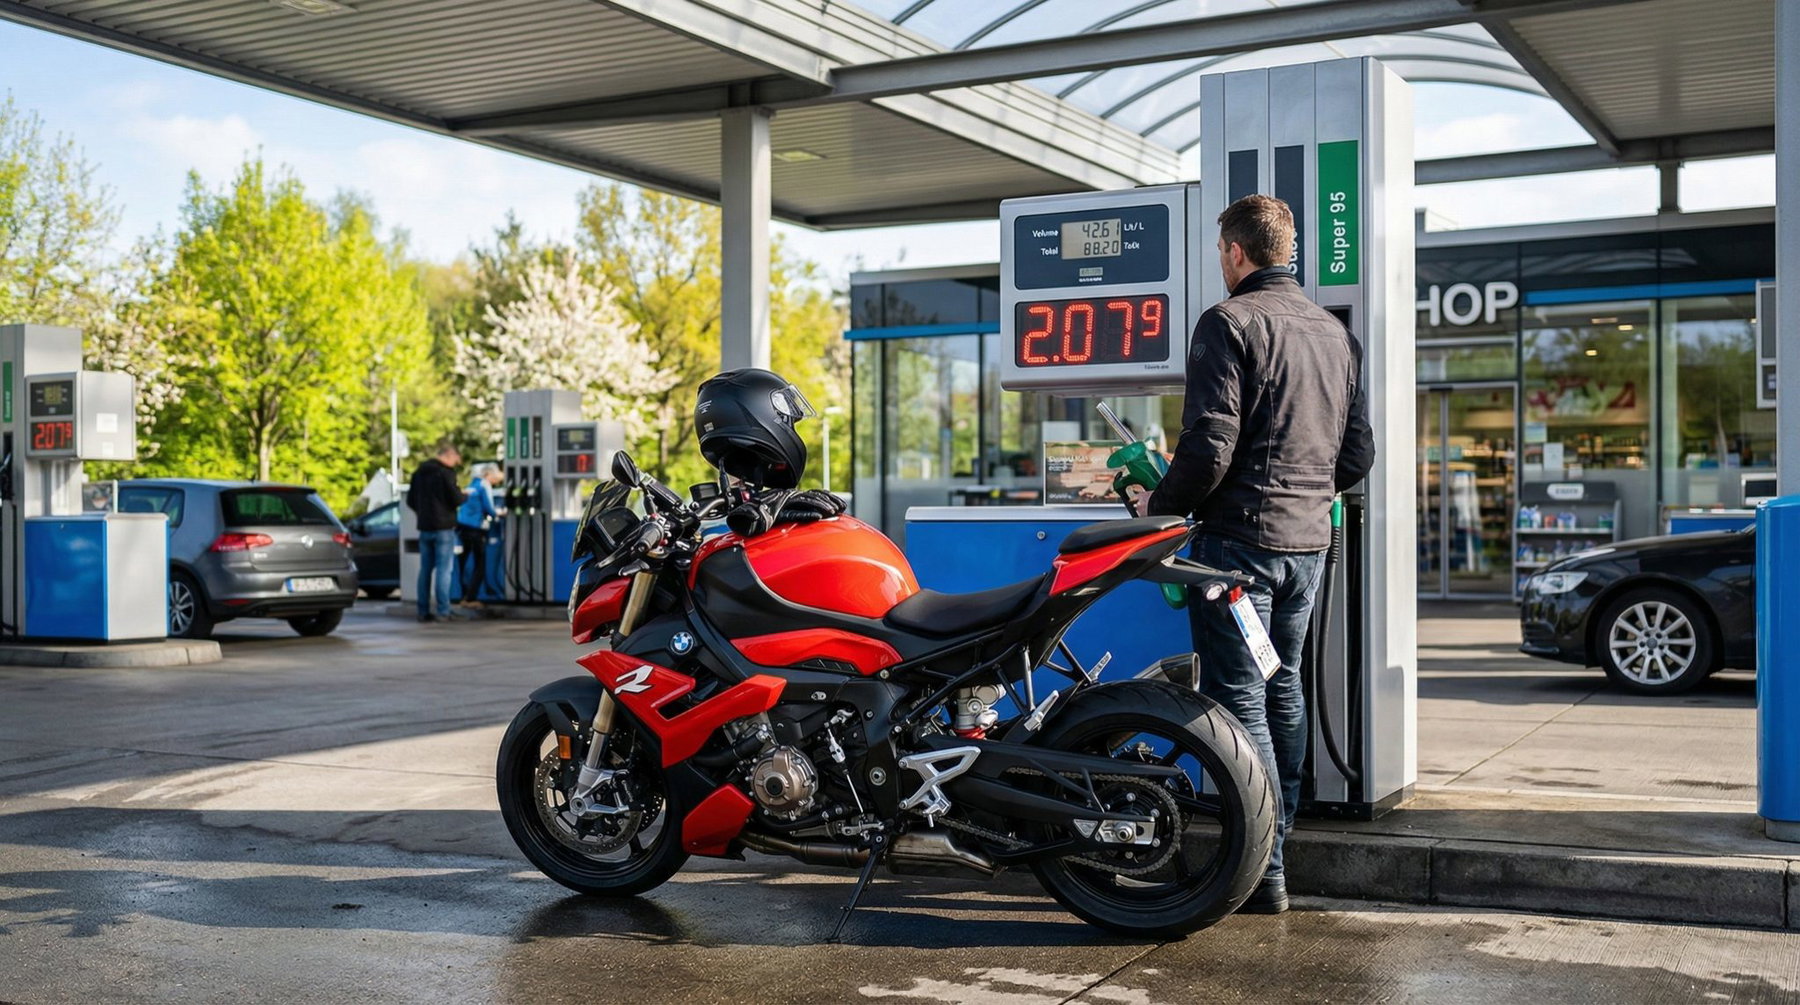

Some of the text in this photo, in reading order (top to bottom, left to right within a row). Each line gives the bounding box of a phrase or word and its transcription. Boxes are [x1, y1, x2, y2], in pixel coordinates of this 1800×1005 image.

[1082, 221, 1120, 239] 42.61
[1084, 240, 1119, 256] 88.20
[1330, 192, 1350, 273] Super 95
[1023, 299, 1162, 363] 2.079
